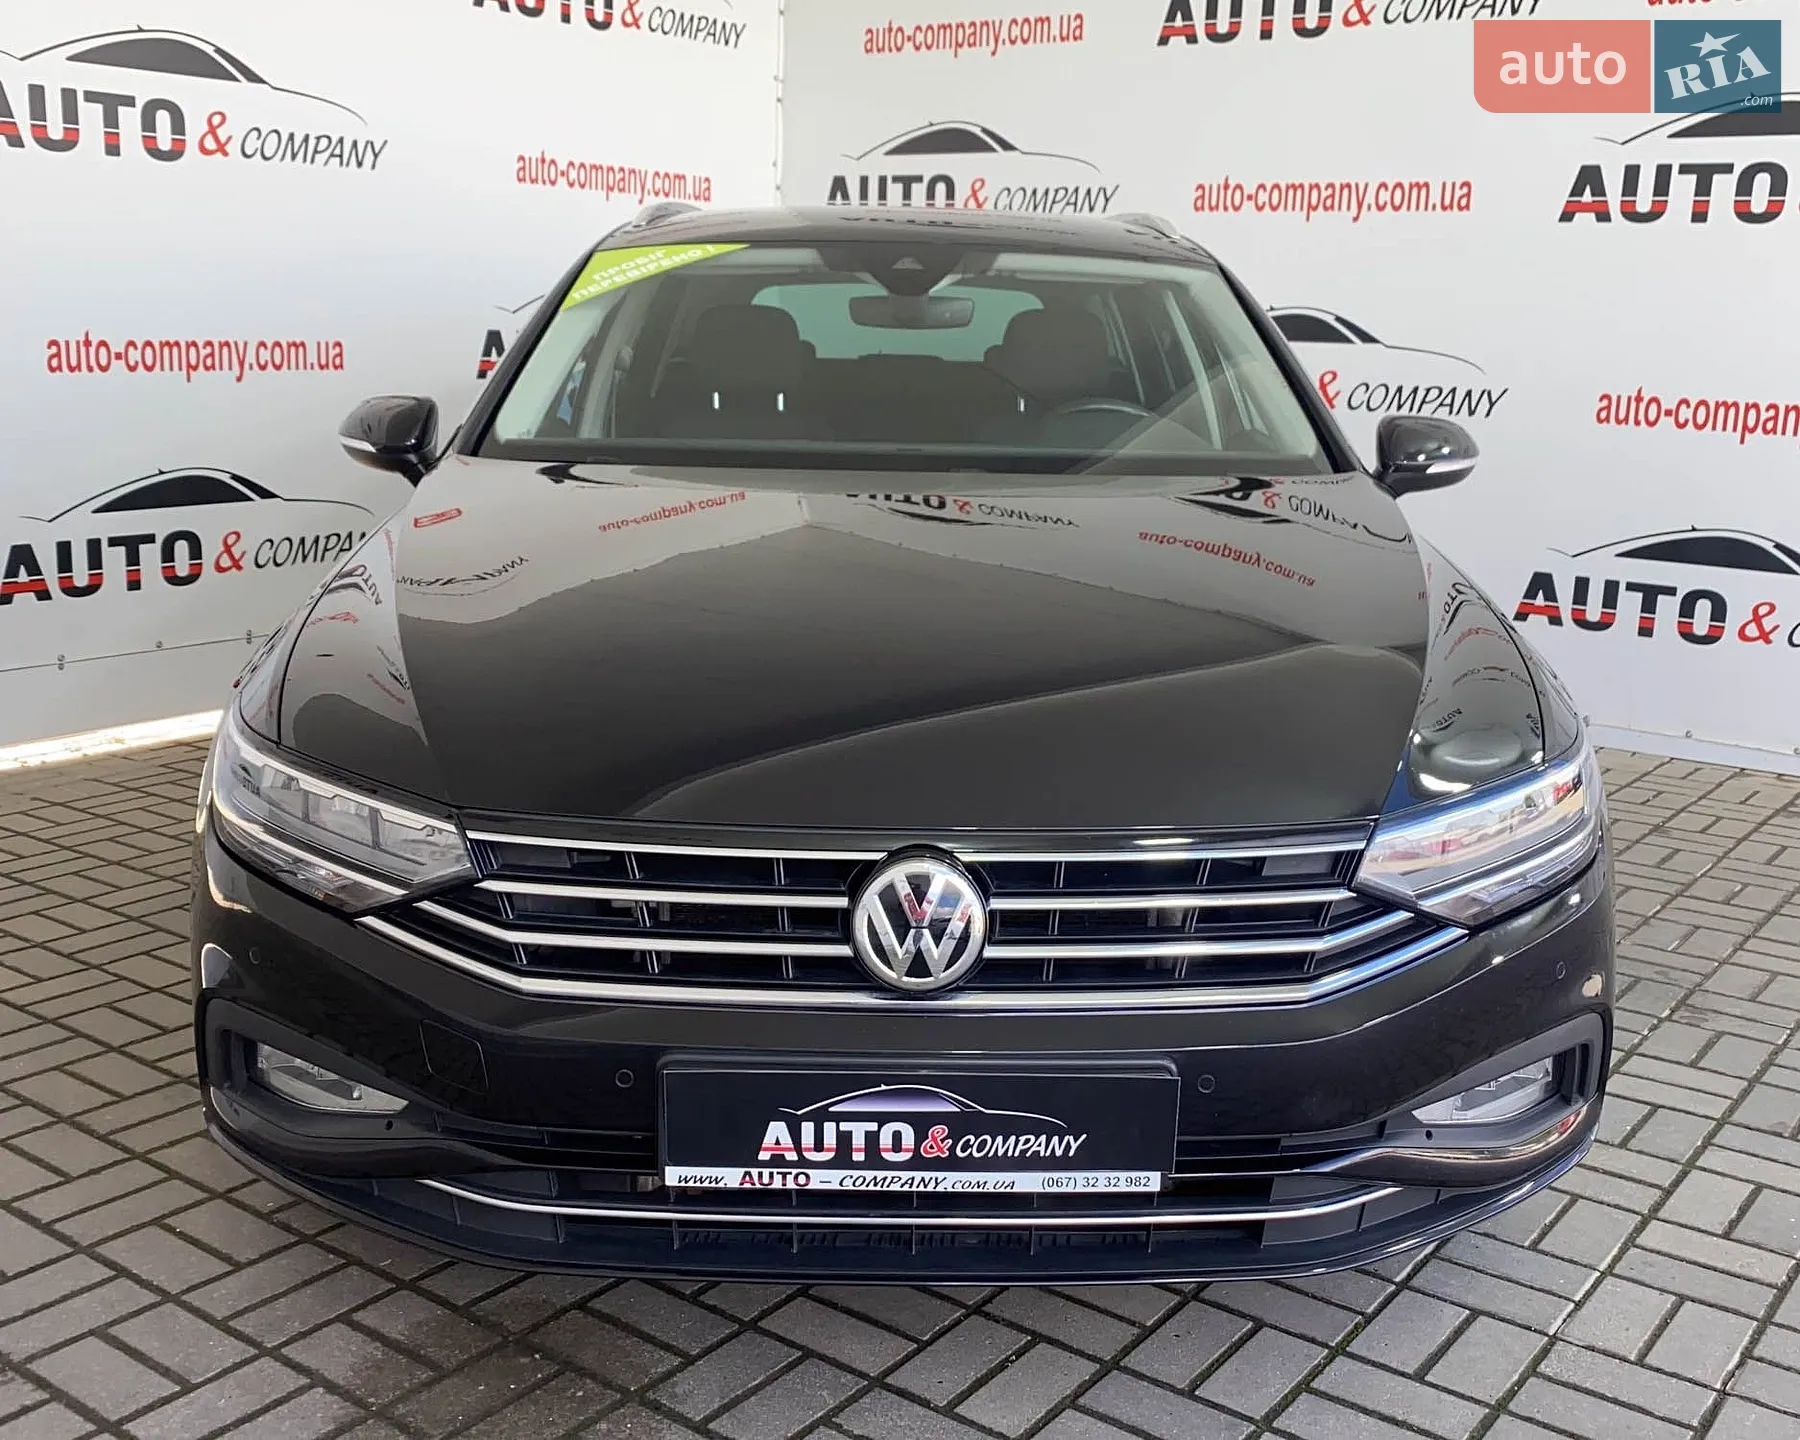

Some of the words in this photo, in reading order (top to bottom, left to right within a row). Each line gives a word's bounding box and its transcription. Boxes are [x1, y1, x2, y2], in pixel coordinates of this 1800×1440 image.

[647, 5, 747, 49] COMPANY
[863, 12, 1084, 58] auto-company.com.ua
[198, 111, 233, 157] &
[240, 127, 388, 171] COMPANY
[516, 149, 712, 205] auto-company.com.ua
[993, 184, 1120, 214] COMPANY
[1193, 175, 1472, 223] auto-company.com.ua
[1558, 161, 1789, 224] AUTO
[46, 330, 345, 383] auto-company.com.ua
[1346, 382, 1509, 418] COMPANY
[1596, 385, 1800, 446] auto-compan
[0, 530, 203, 605] AUTO
[213, 530, 247, 575] &
[254, 530, 367, 569] COMPA
[1512, 571, 1728, 645] AUTO
[1737, 601, 1781, 645] &
[757, 1120, 916, 1162] AUTO
[920, 1124, 953, 1159] &
[956, 1133, 1088, 1159] COMPANY
[677, 1174, 728, 1187] www.
[739, 1170, 811, 1188] AUTO
[1041, 1175, 1077, 1191] (067)
[1082, 1176, 1099, 1188] 32
[1103, 1176, 1121, 1188] 32
[1125, 1176, 1151, 1188] 982
